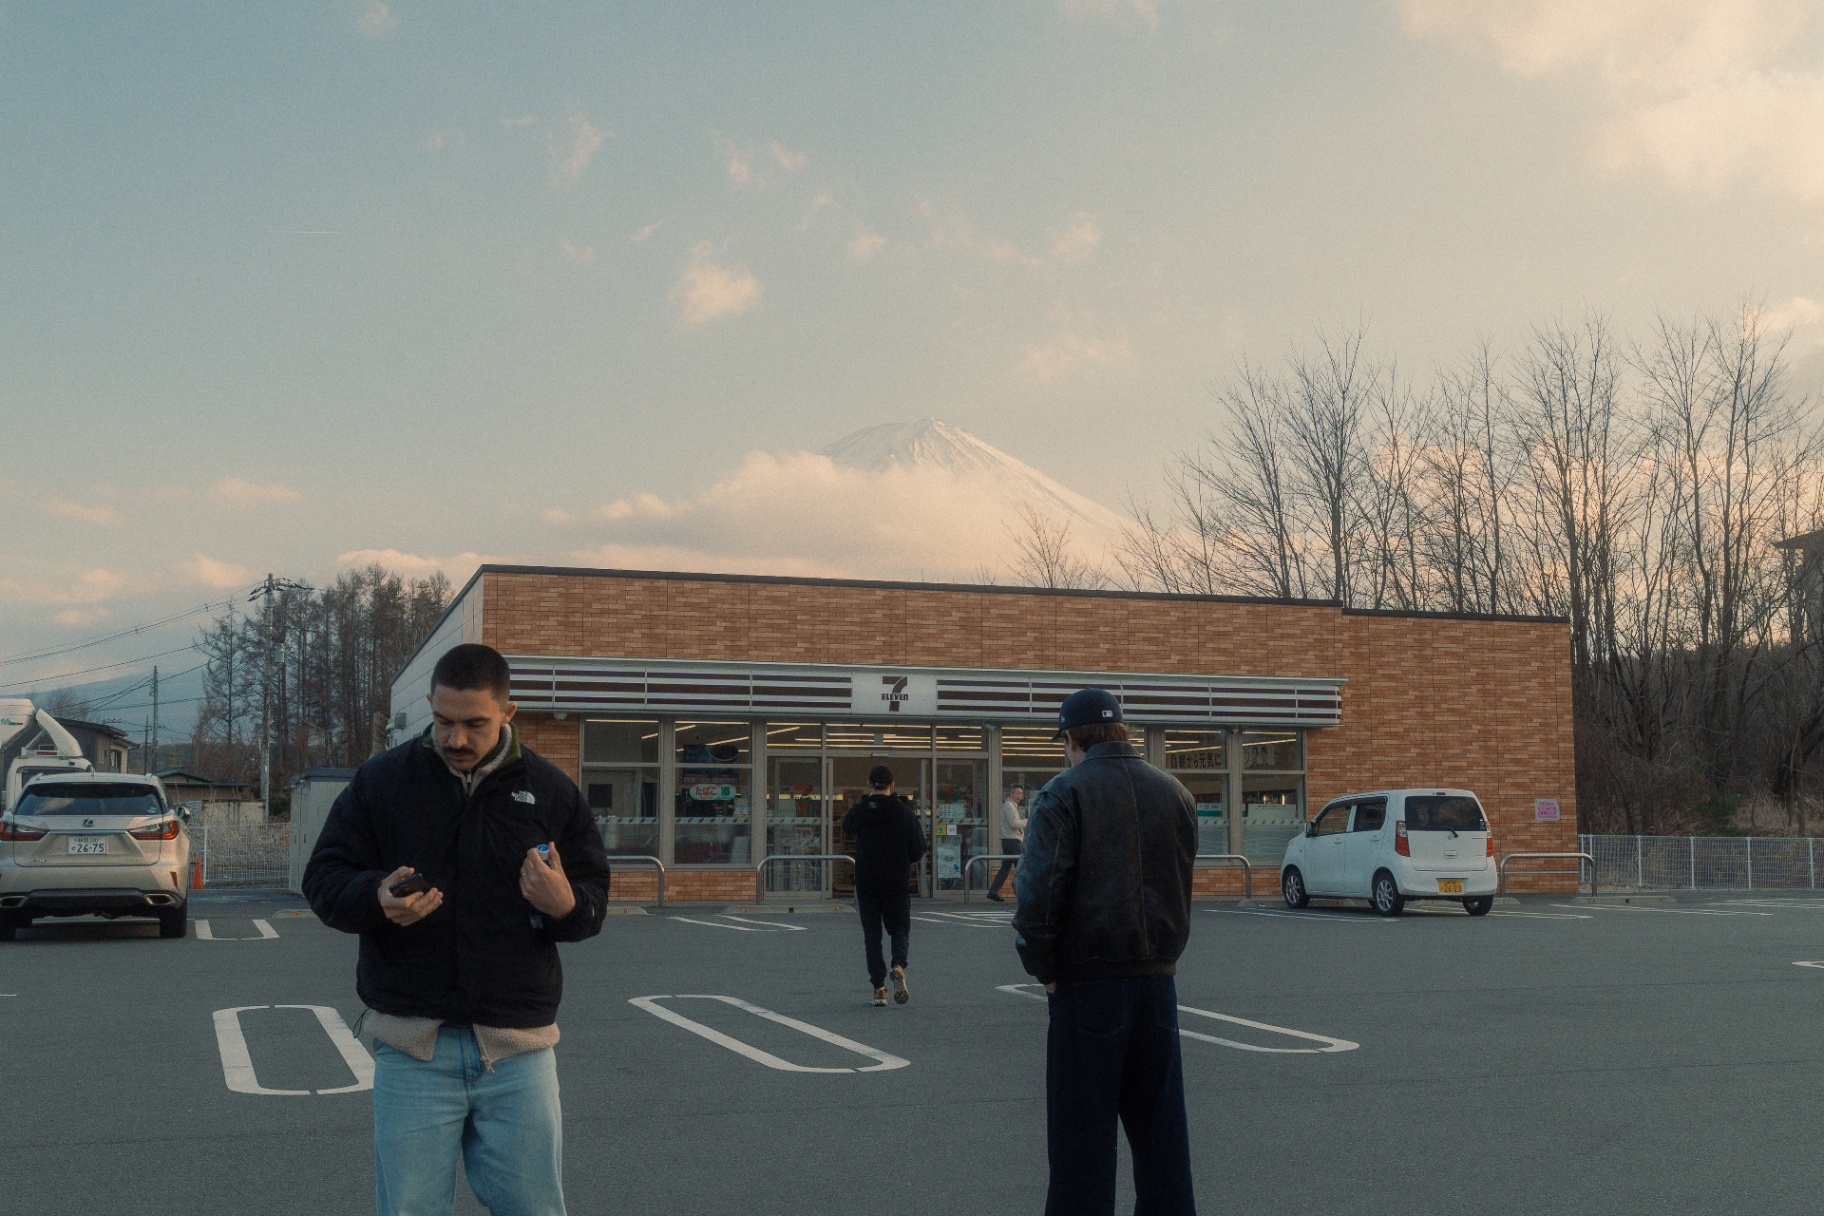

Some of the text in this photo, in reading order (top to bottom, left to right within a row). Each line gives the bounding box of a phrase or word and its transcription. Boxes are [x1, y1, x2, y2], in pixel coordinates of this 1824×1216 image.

[882, 676, 908, 712] 7
[695, 785, 717, 796] たばこ
[76, 843, 105, 853] 26-75
